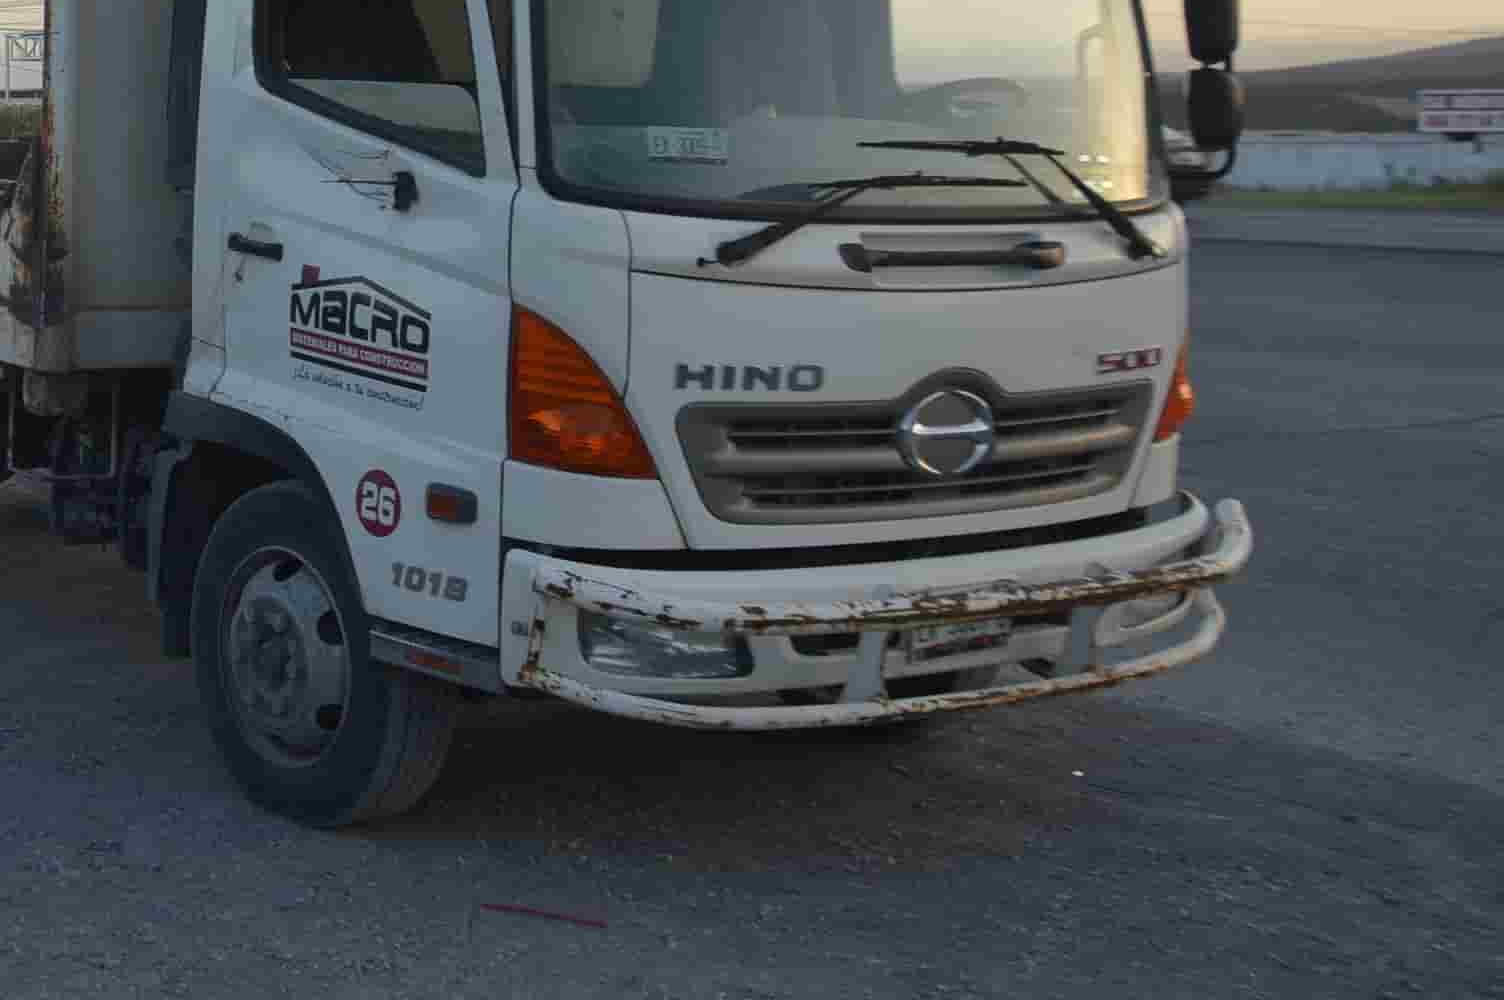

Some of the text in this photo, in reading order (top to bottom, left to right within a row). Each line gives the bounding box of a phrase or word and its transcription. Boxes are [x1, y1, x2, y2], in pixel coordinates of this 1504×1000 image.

[1096, 348, 1162, 375] 500
[674, 363, 825, 392] HINO
[362, 480, 396, 527] 26
